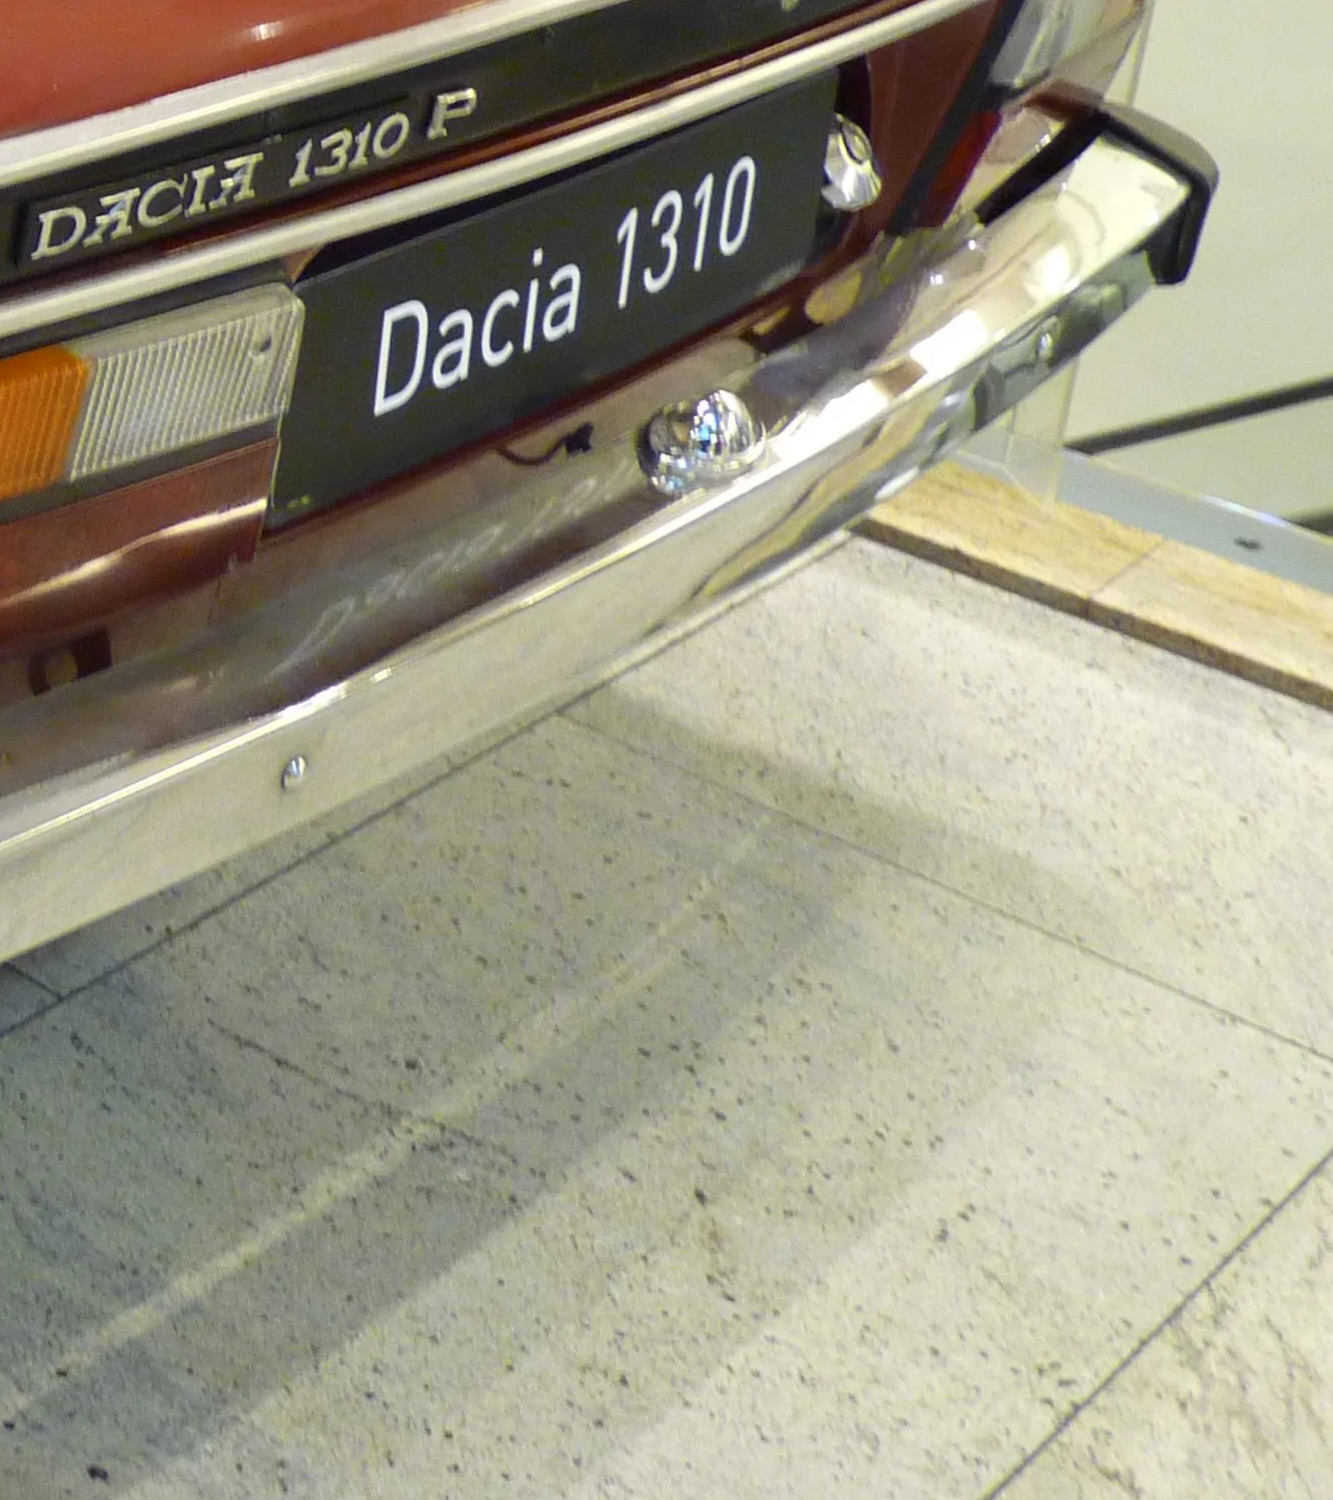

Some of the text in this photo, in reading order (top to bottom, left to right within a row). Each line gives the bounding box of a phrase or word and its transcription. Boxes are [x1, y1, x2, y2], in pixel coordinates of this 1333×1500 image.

[31, 87, 477, 260] DACIA 1310 P
[374, 155, 757, 417] Dacia 1310
